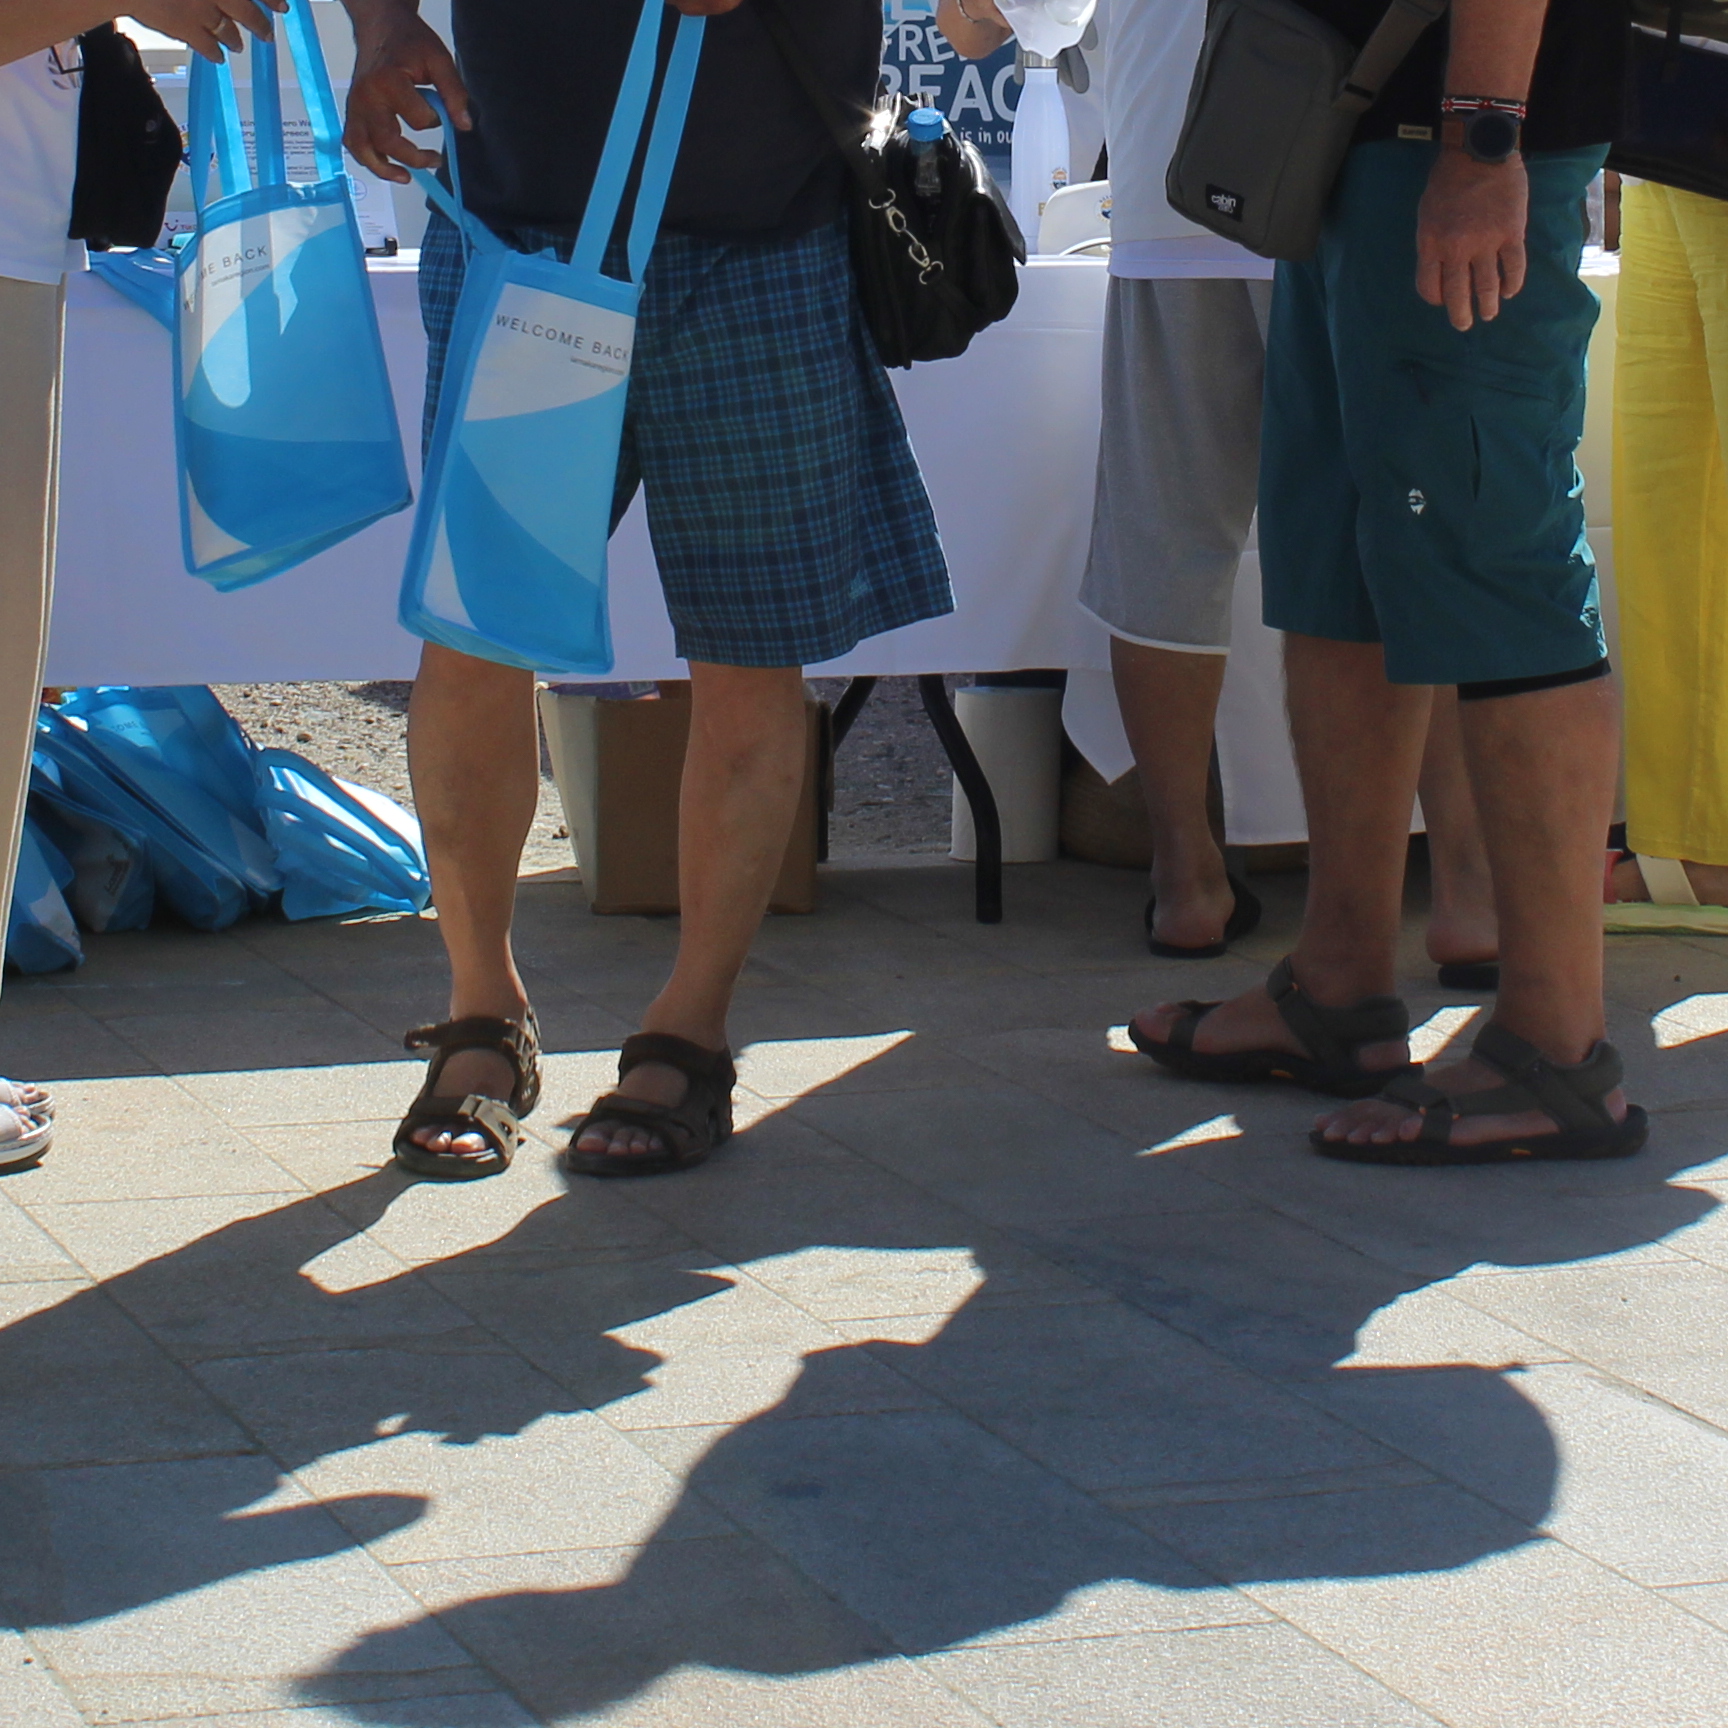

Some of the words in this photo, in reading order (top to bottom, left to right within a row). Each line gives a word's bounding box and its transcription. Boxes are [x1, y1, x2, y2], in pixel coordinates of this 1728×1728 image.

[960, 128, 972, 143] is
[978, 128, 992, 143] in
[997, 130, 1012, 144] ou
[1211, 192, 1237, 208] cabin
[223, 245, 268, 268] BACK
[496, 314, 584, 349] WELCOME
[592, 341, 629, 362] BACK
